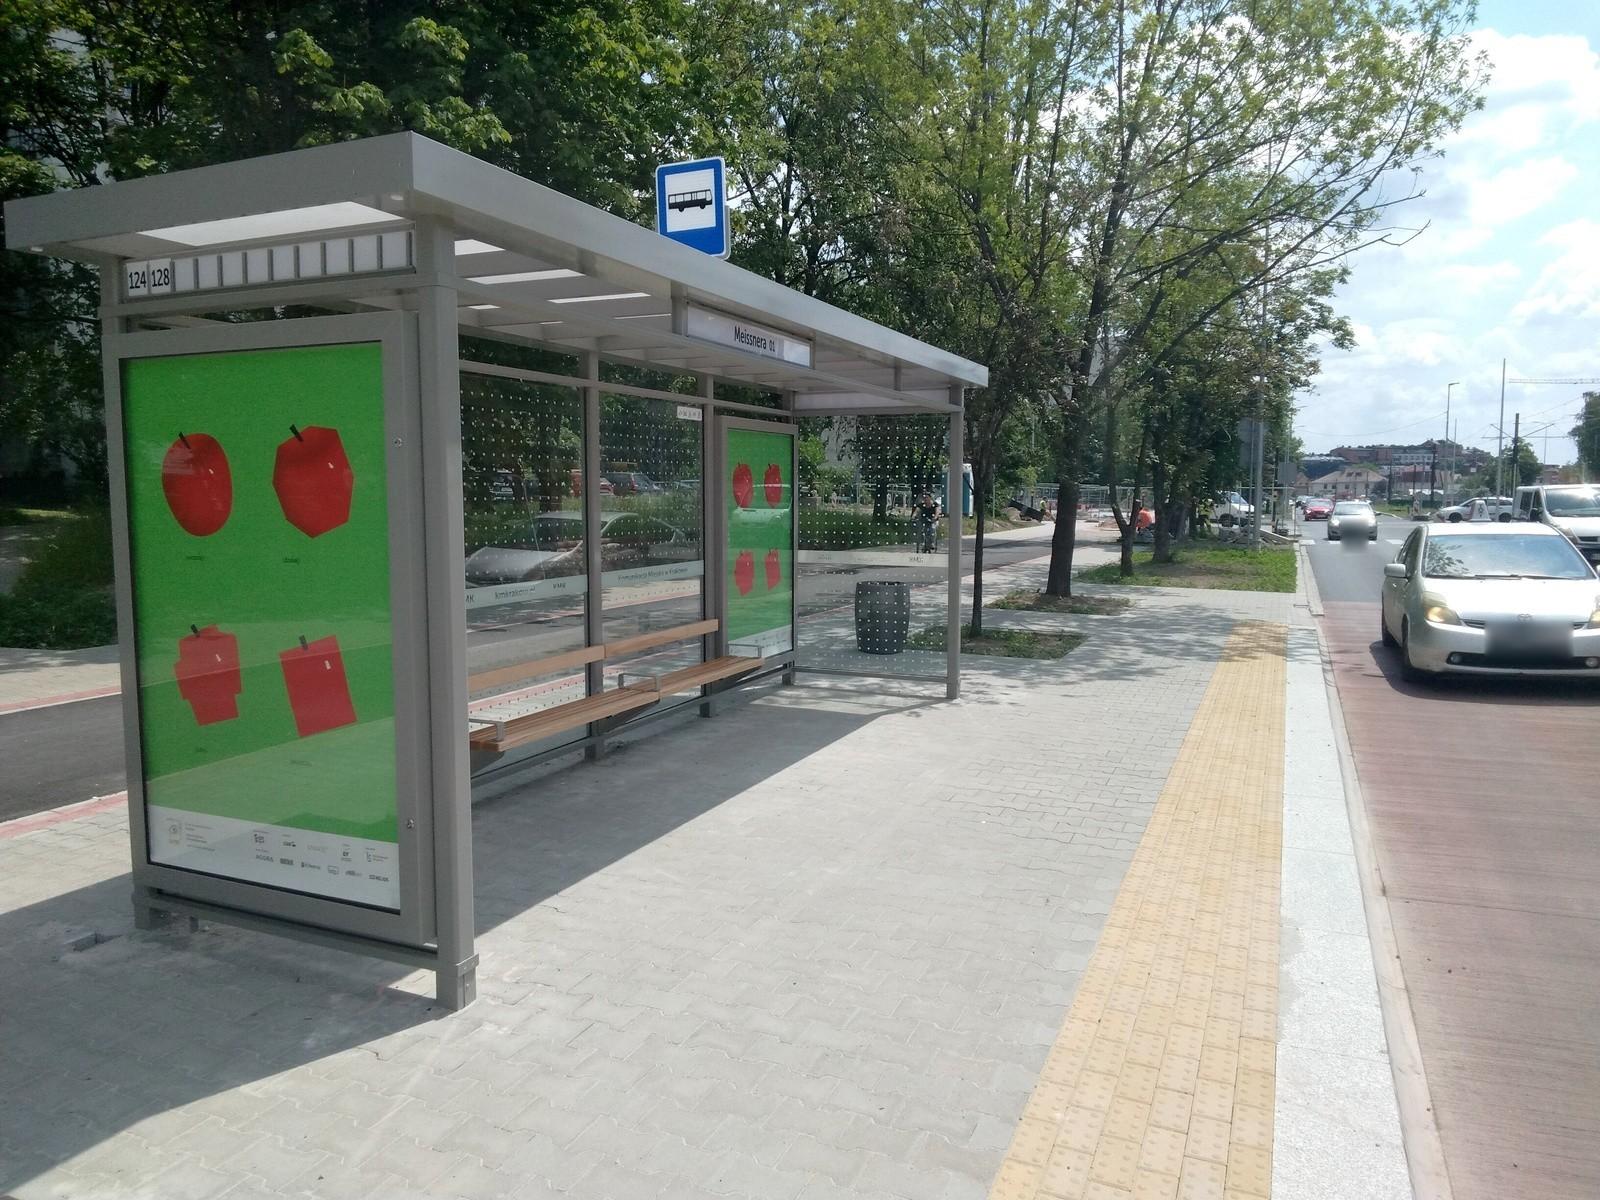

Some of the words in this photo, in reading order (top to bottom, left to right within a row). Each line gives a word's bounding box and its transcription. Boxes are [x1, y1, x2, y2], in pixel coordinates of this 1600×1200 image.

[128, 271, 147, 289] 124
[151, 268, 170, 287] 128
[734, 326, 767, 350] Meissnera
[769, 340, 776, 352] 01
